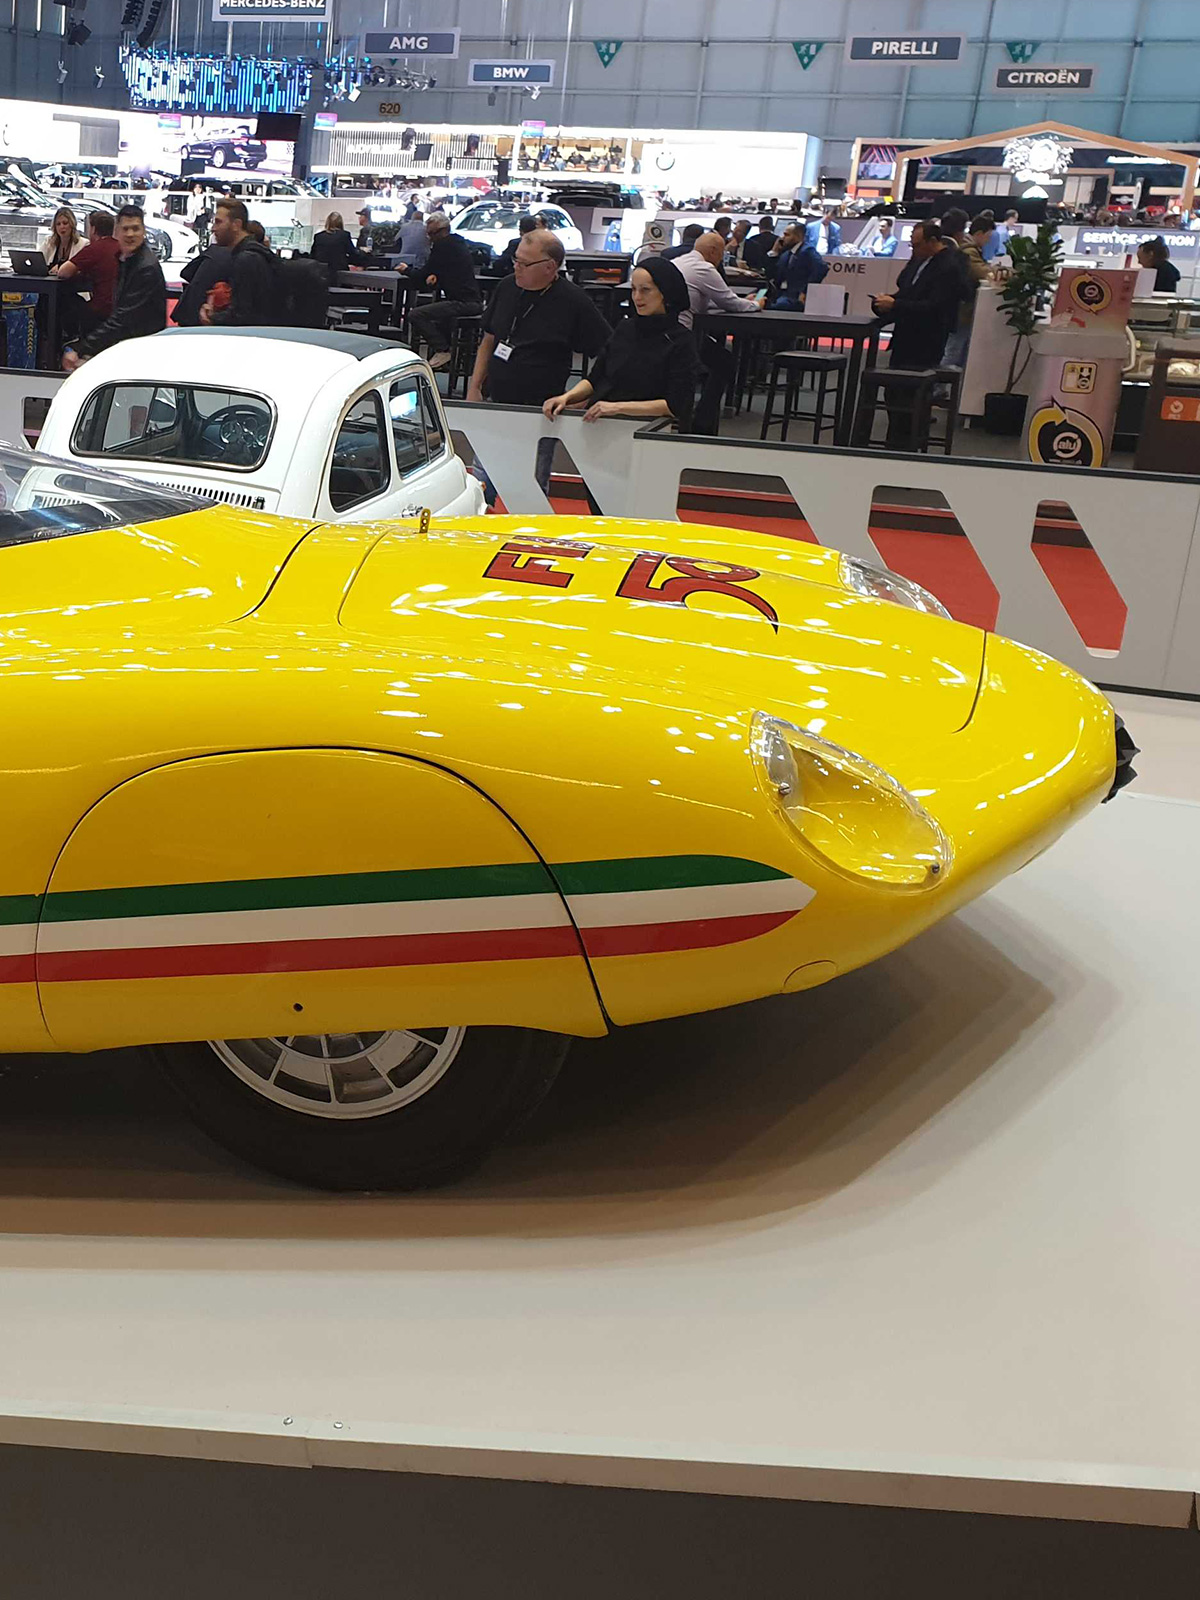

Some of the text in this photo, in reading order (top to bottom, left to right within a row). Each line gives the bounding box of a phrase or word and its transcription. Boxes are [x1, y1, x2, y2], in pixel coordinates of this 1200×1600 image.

[220, 0, 326, 8] MERCEDES-BENZ
[389, 36, 429, 50] AMG
[871, 41, 939, 55] PIRELLI
[493, 67, 530, 79] BMW
[1007, 69, 1080, 84] CITROËN
[379, 103, 401, 114] 620
